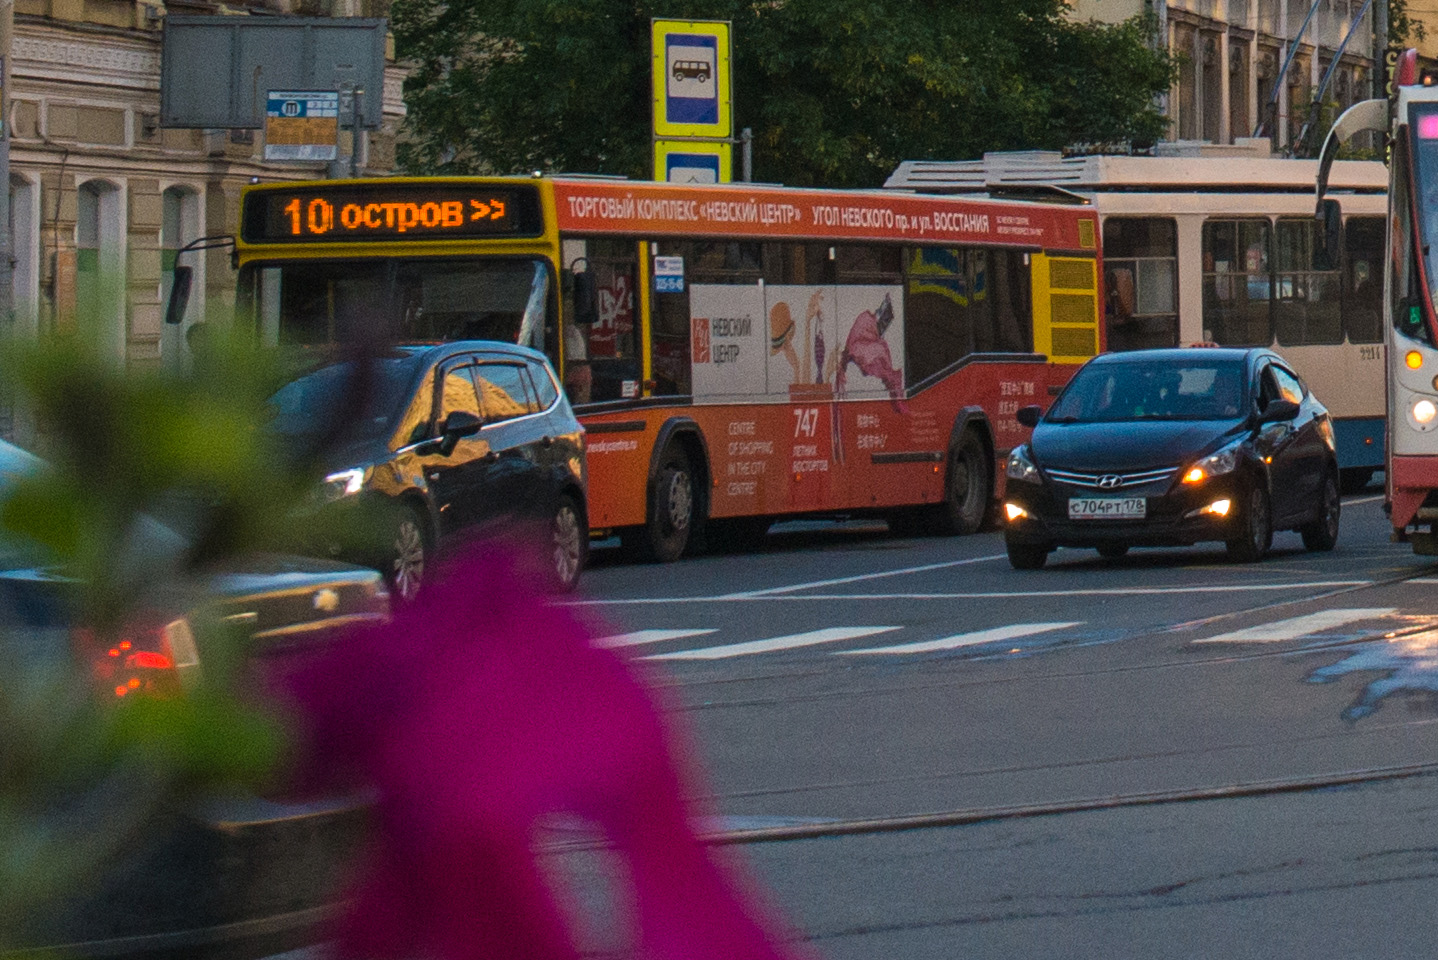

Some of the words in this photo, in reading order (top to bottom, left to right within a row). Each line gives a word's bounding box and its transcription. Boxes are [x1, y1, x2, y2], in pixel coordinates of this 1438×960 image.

[285, 198, 330, 234] 10
[567, 193, 634, 219] ТОРГОВЫЙ
[637, 197, 698, 220] КОМПЛЕКС
[812, 206, 840, 226] УГОЛ
[841, 207, 894, 228] НЕВСКОГО
[933, 211, 990, 233] ВОССТАНИЯ
[713, 314, 752, 337] НЕВСКИЙ
[713, 345, 740, 368] ЦЕНТР
[728, 421, 756, 436] CENTRE
[793, 408, 819, 438] 747
